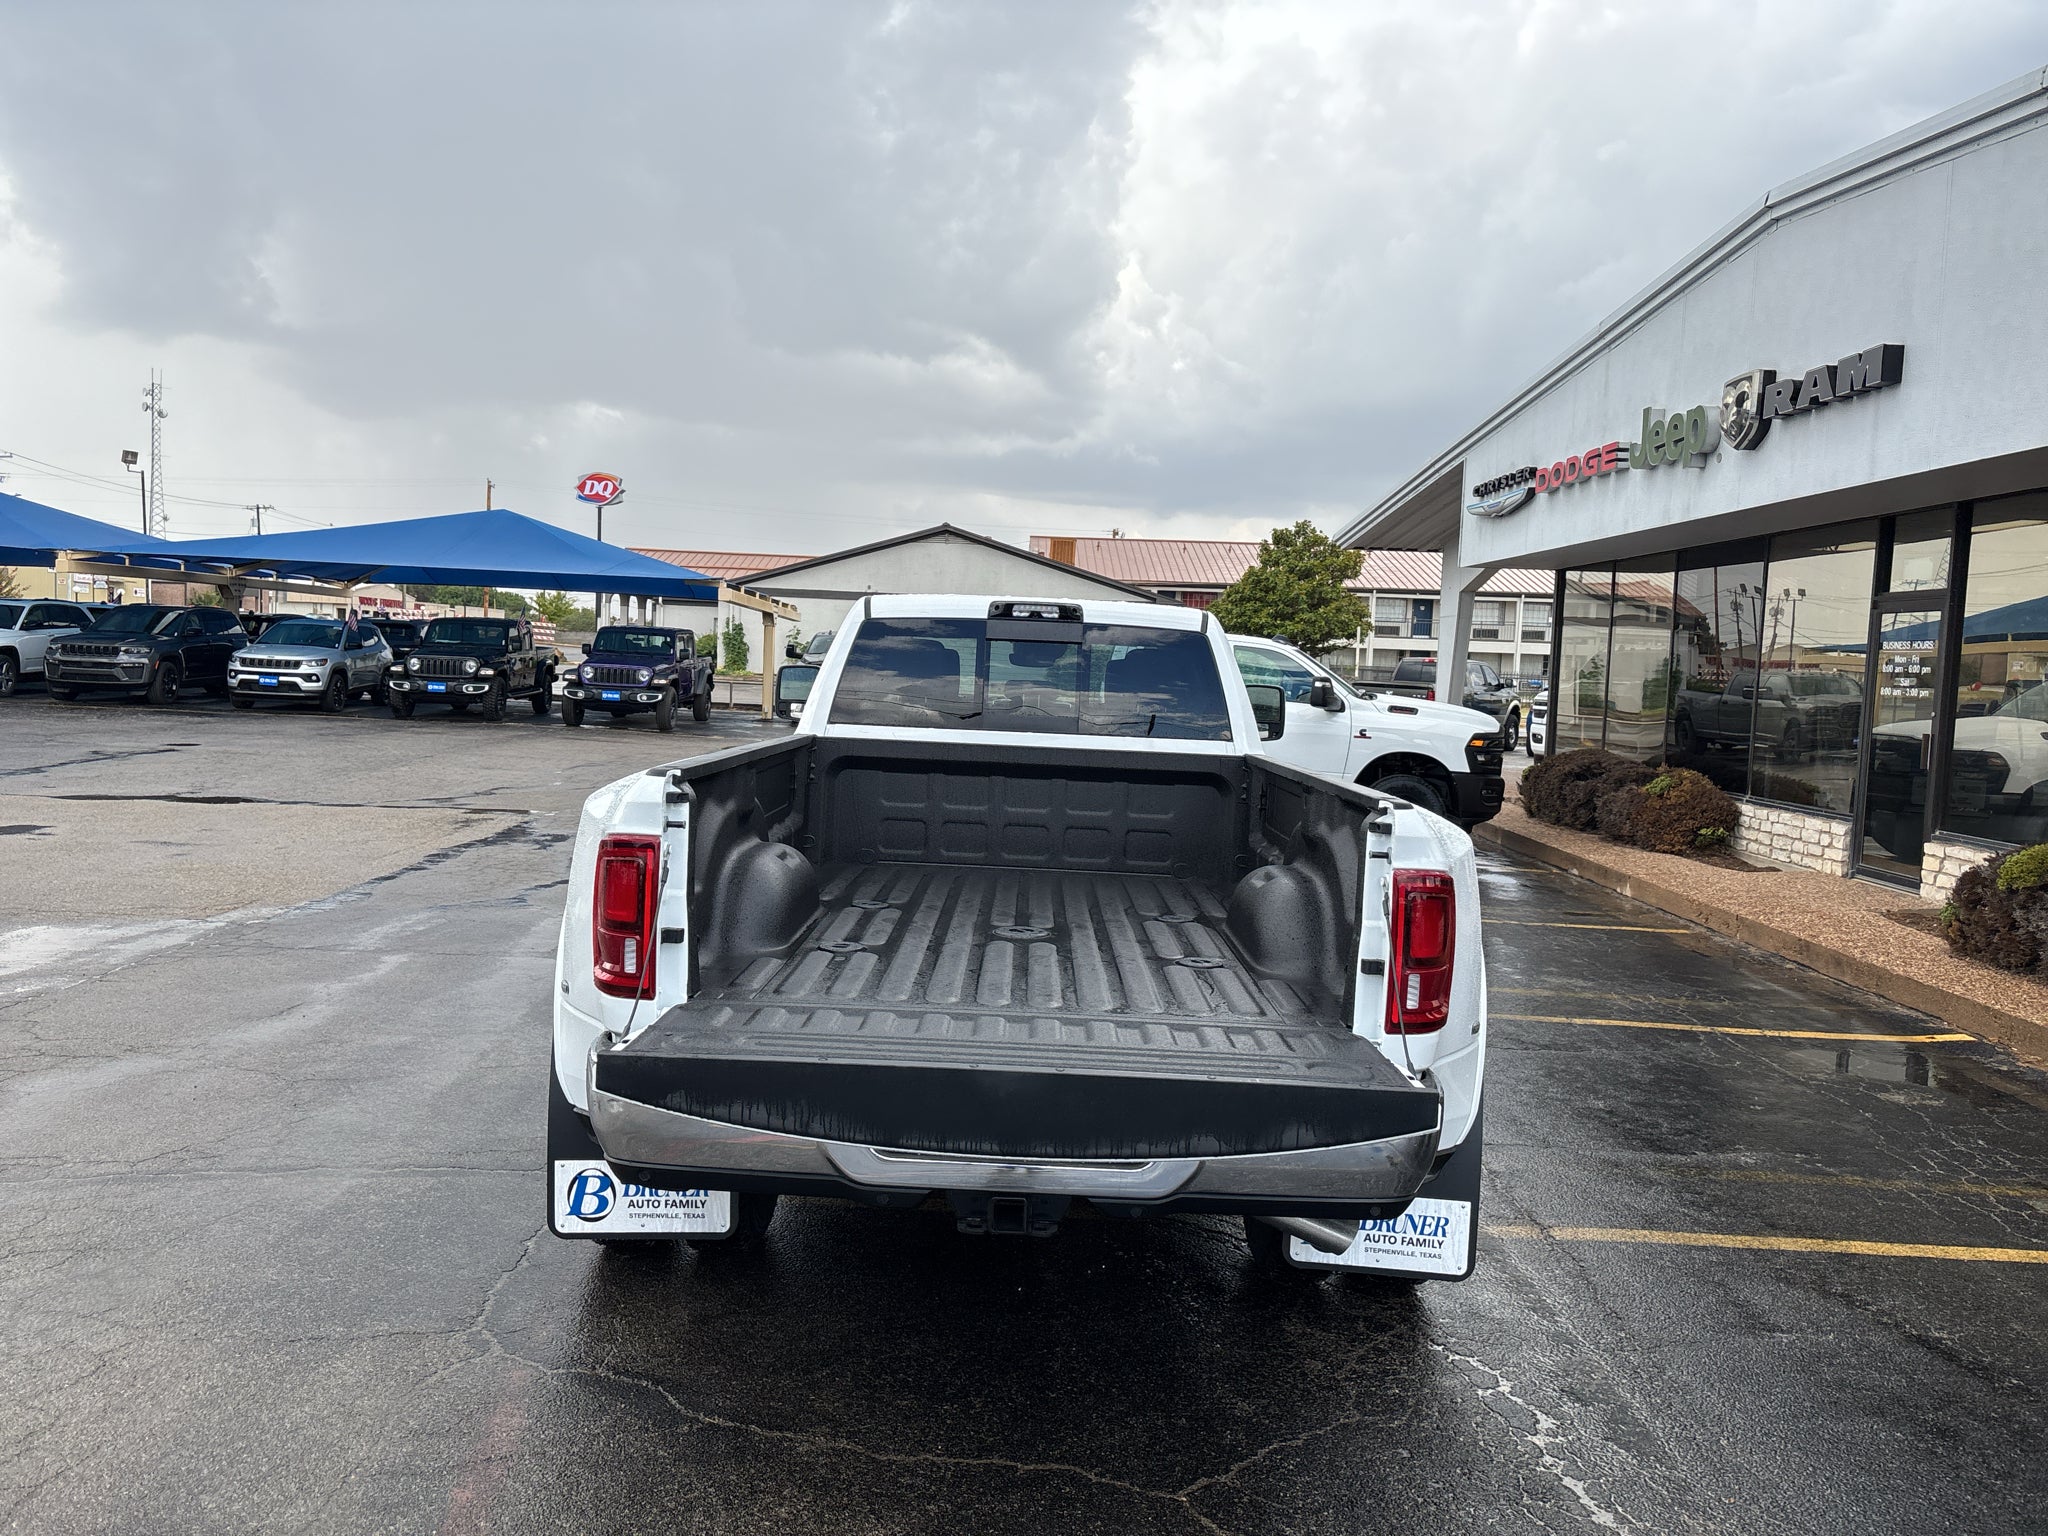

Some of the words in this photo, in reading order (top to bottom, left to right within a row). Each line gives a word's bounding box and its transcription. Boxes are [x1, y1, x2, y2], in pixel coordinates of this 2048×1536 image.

[1763, 343, 1888, 419] RAM
[1630, 405, 1708, 470] Jeep
[1535, 441, 1621, 494] DODGE
[583, 479, 614, 498] DQ
[1473, 467, 1534, 498] CHRYSLER
[1882, 641, 1911, 650] BUSINESS
[1894, 654, 1907, 663] Mon
[1911, 654, 1920, 664] Fri
[1921, 666, 1932, 676] pm
[1919, 690, 1929, 699] pm
[566, 1175, 611, 1216] B
[627, 1199, 661, 1209] AUTO
[664, 1199, 707, 1209] FAMILY
[1363, 1233, 1397, 1245] AUTO
[1401, 1236, 1445, 1250] FAMILY
[1364, 1246, 1418, 1258] STEPHENVILLE,
[1419, 1251, 1442, 1260] TEXAS
